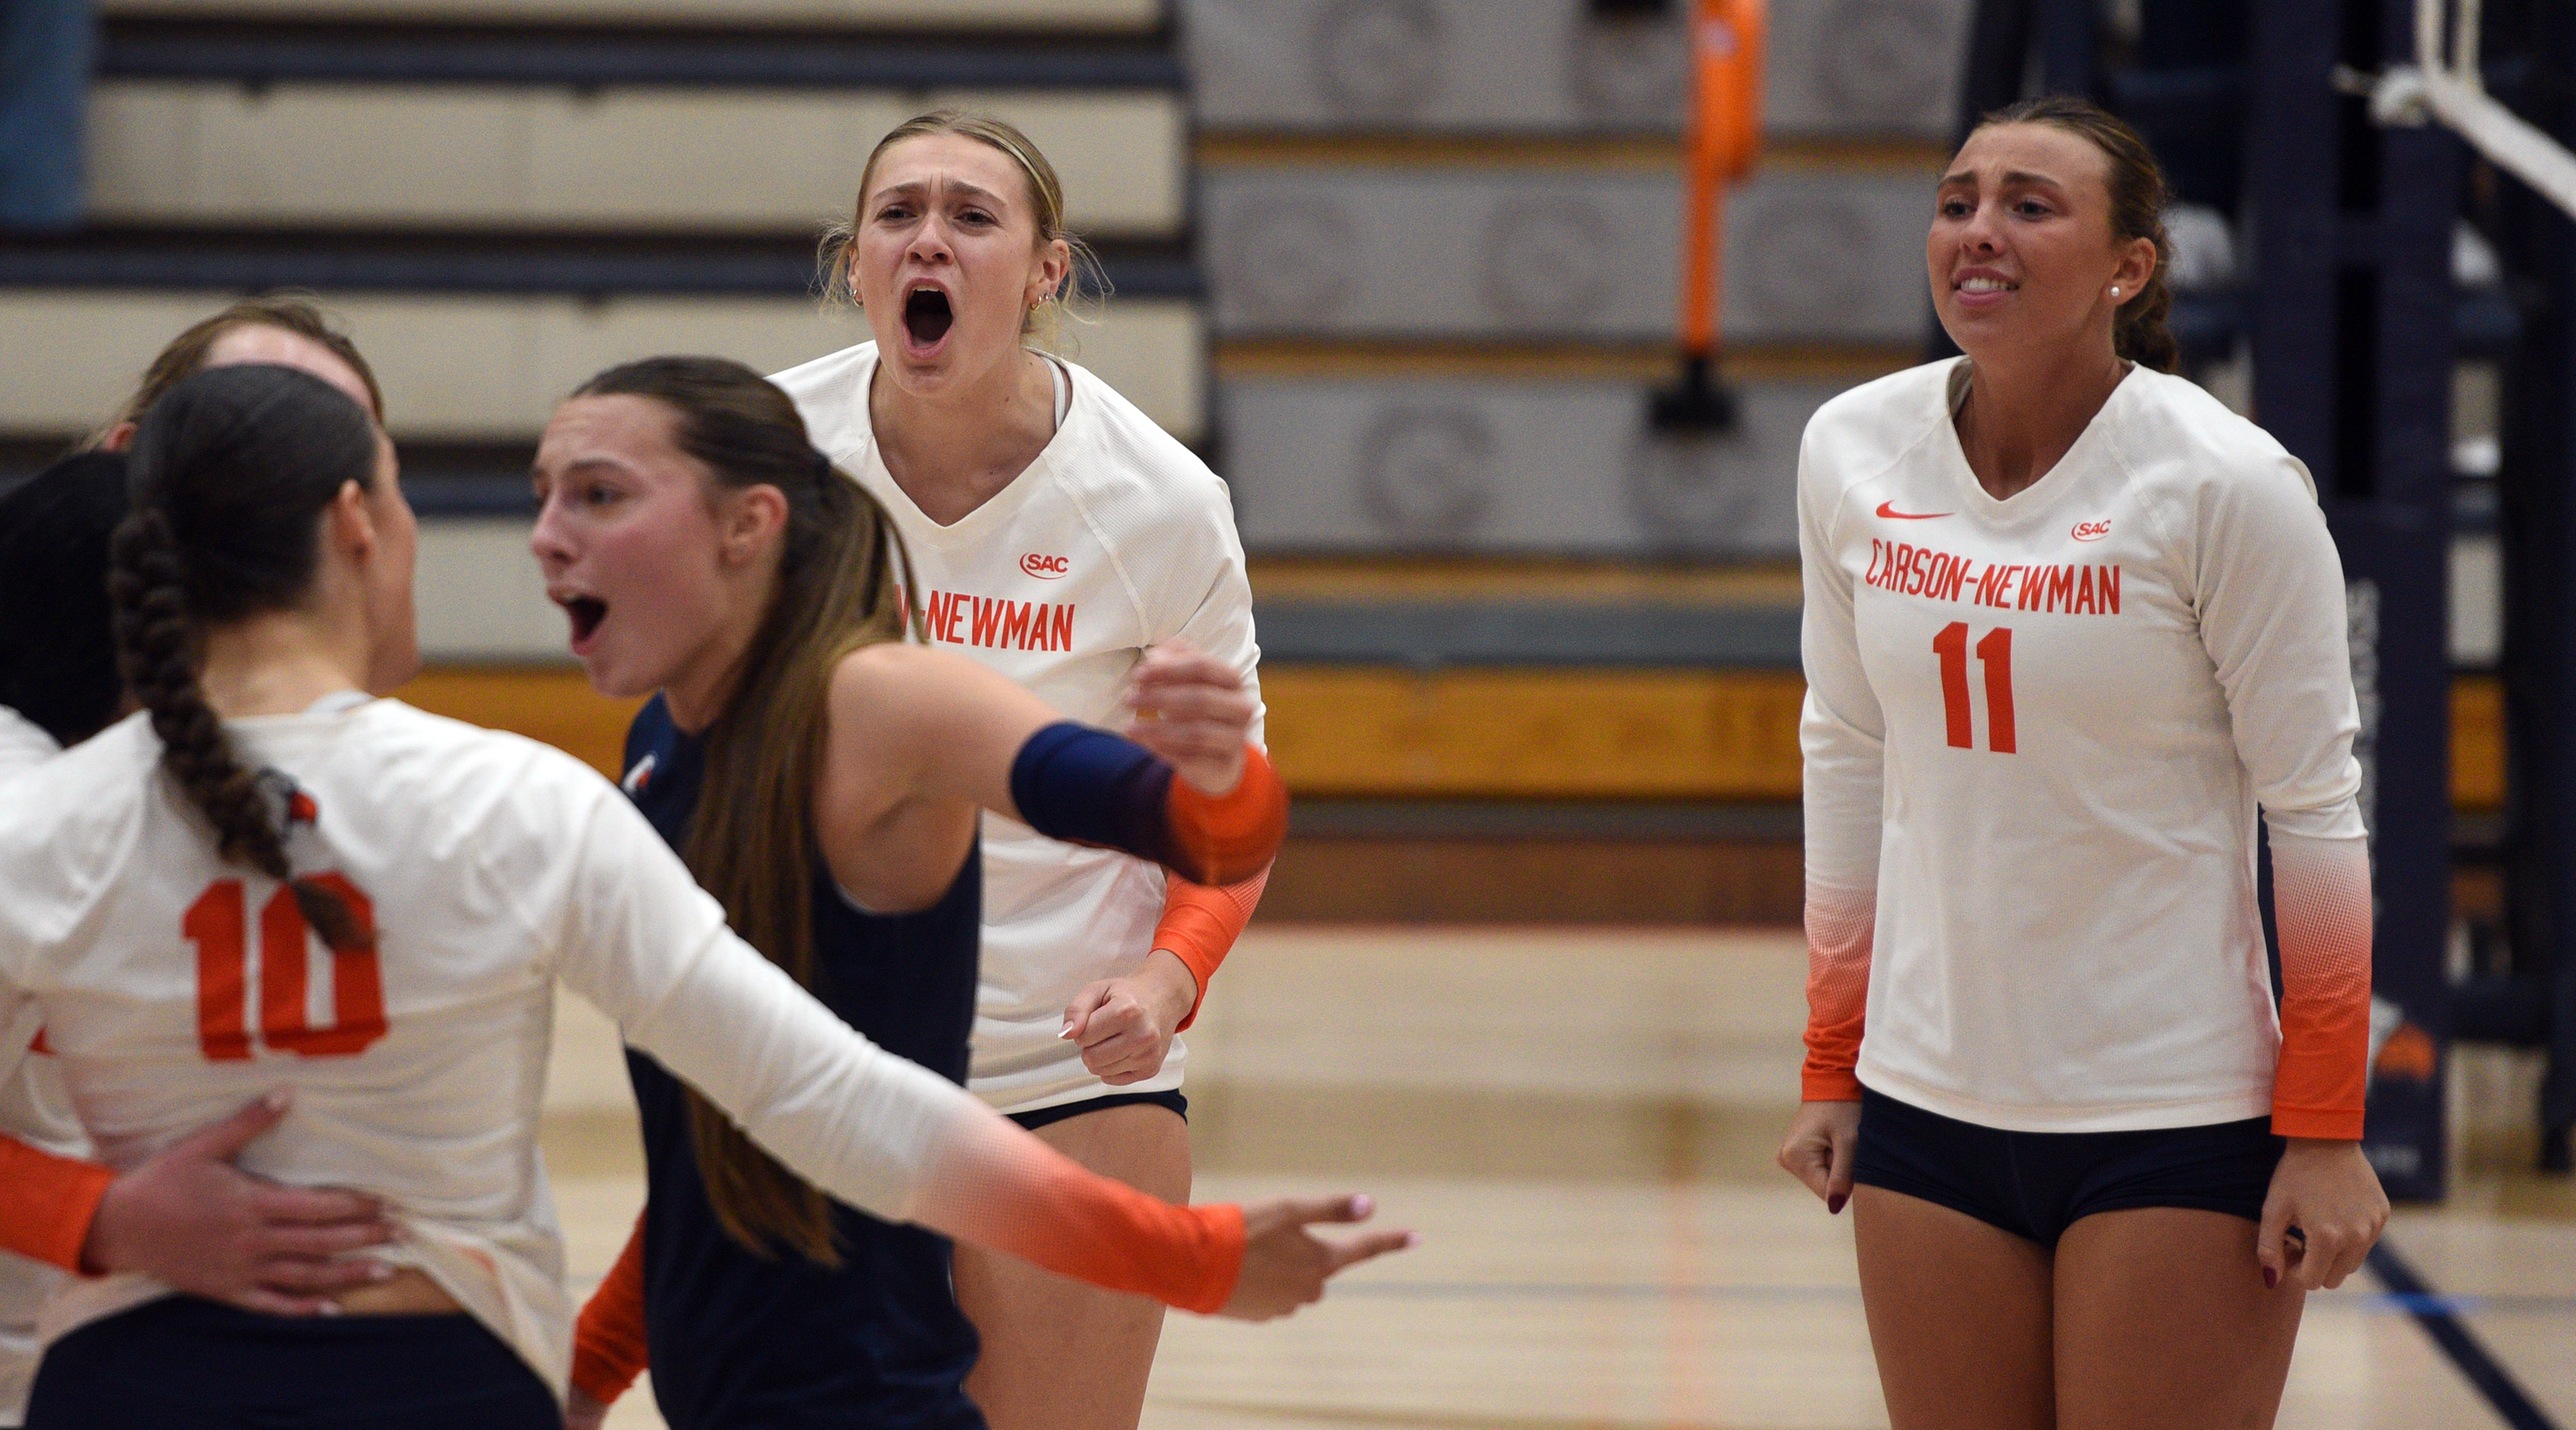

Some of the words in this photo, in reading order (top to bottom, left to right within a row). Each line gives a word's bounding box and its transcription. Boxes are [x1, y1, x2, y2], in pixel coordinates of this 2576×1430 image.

[1025, 553, 1069, 573] SAC
[2077, 519, 2111, 536] SAC
[1865, 537, 2120, 615] CARSON-NEWMAN
[1933, 621, 2016, 754] 11
[181, 869, 388, 1061] 10
